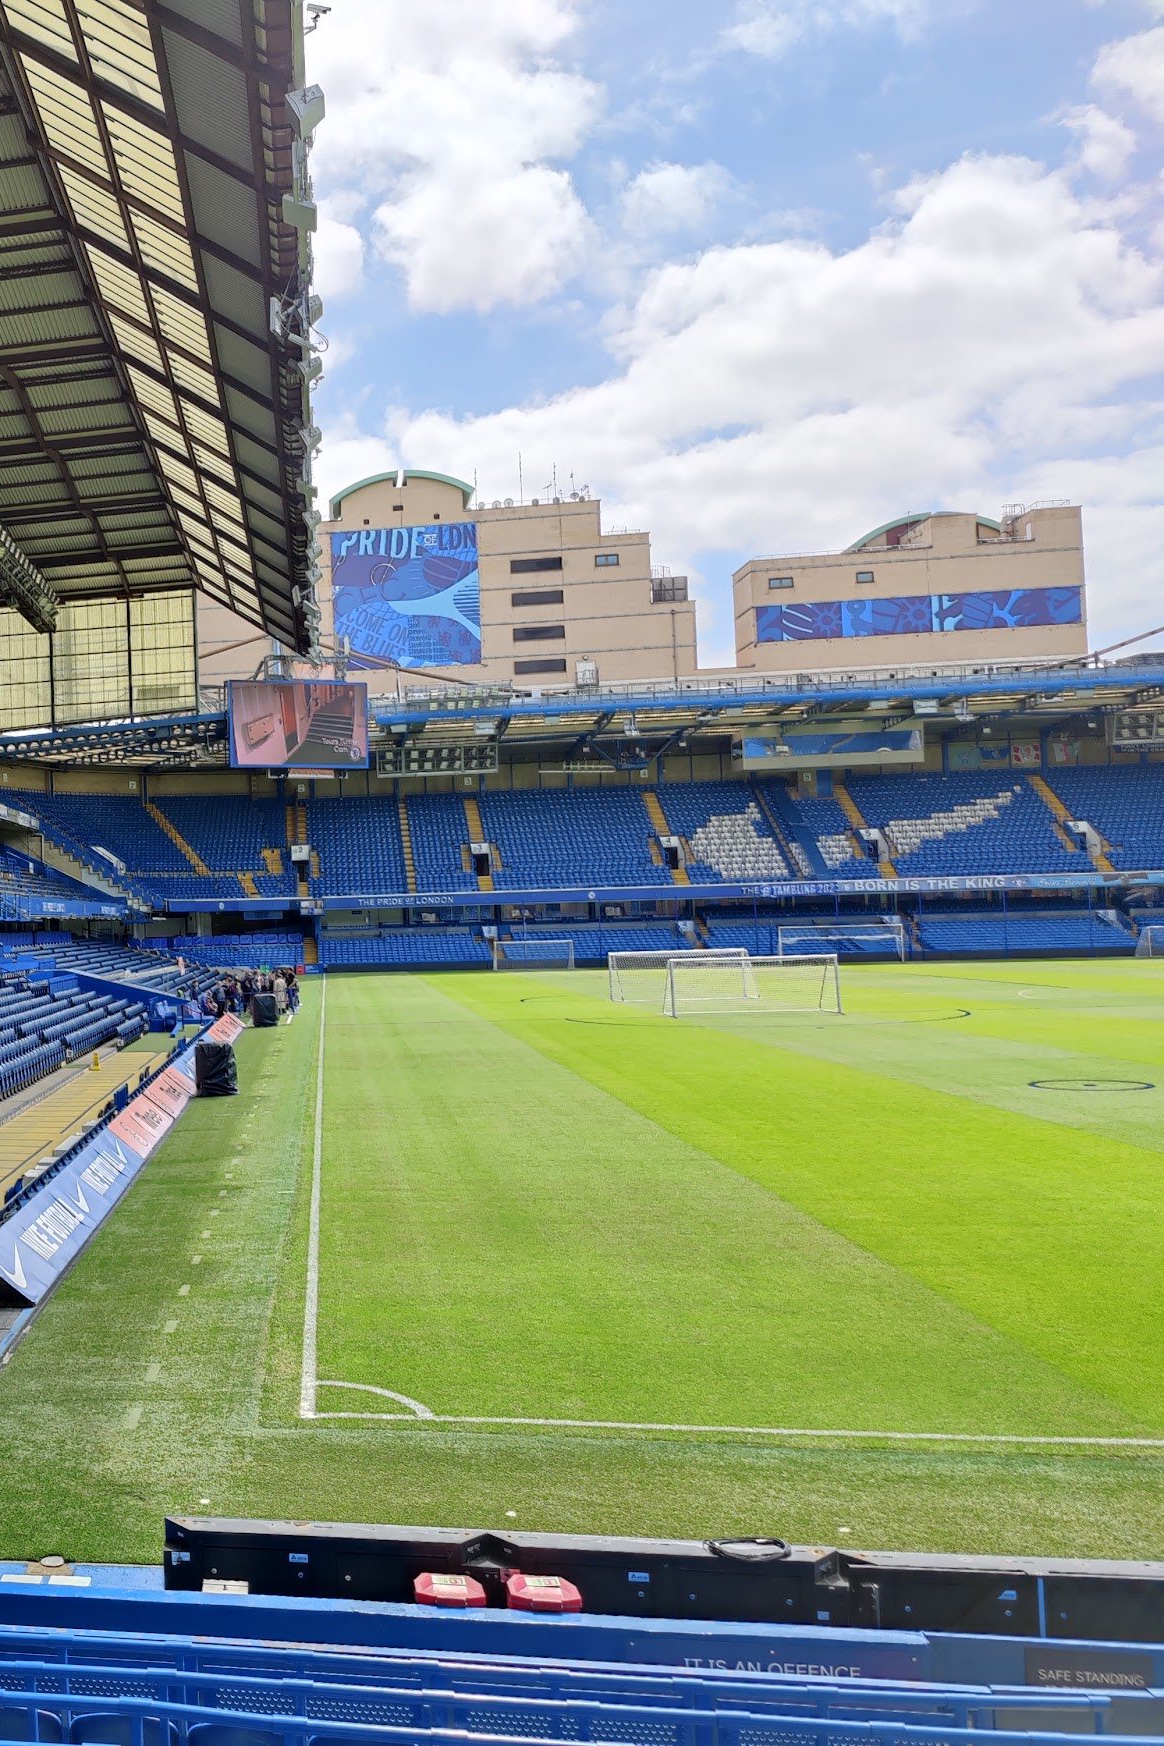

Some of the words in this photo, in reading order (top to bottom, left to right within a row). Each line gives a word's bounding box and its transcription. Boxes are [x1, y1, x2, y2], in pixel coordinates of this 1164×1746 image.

[340, 526, 426, 560] PRIDE
[424, 534, 437, 545] OF
[438, 524, 477, 551] LDN
[346, 607, 385, 637] COME
[388, 622, 408, 648] ON
[338, 620, 363, 646] THE
[361, 631, 406, 659] BLUES
[321, 737, 339, 745] Tours
[339, 737, 360, 746] Tunnel
[333, 745, 348, 753] Cam
[465, 777, 471, 785] 3
[804, 773, 810, 781] 5
[865, 829, 872, 838] 5
[477, 843, 483, 851] 3
[741, 886, 759, 895] THE
[772, 883, 816, 896] TAMBLING
[854, 880, 899, 891] BORN
[905, 880, 920, 890] IS
[927, 879, 959, 890] THE
[965, 877, 1007, 889] KING
[358, 898, 375, 907] THE
[377, 897, 404, 906] PRIDE
[405, 897, 415, 905] OF
[416, 895, 454, 905] LONDON
[89, 1150, 125, 1186] FOOTBALL
[80, 1167, 110, 1196] NIKE
[35, 1197, 85, 1245] FOOTBALL
[19, 1223, 60, 1261] NIKE
[683, 1657, 703, 1669] IT
[708, 1658, 727, 1670] IS
[736, 1660, 761, 1673] AN
[1037, 1668, 1072, 1682] SAFE
[1075, 1670, 1145, 1687] STANDING
